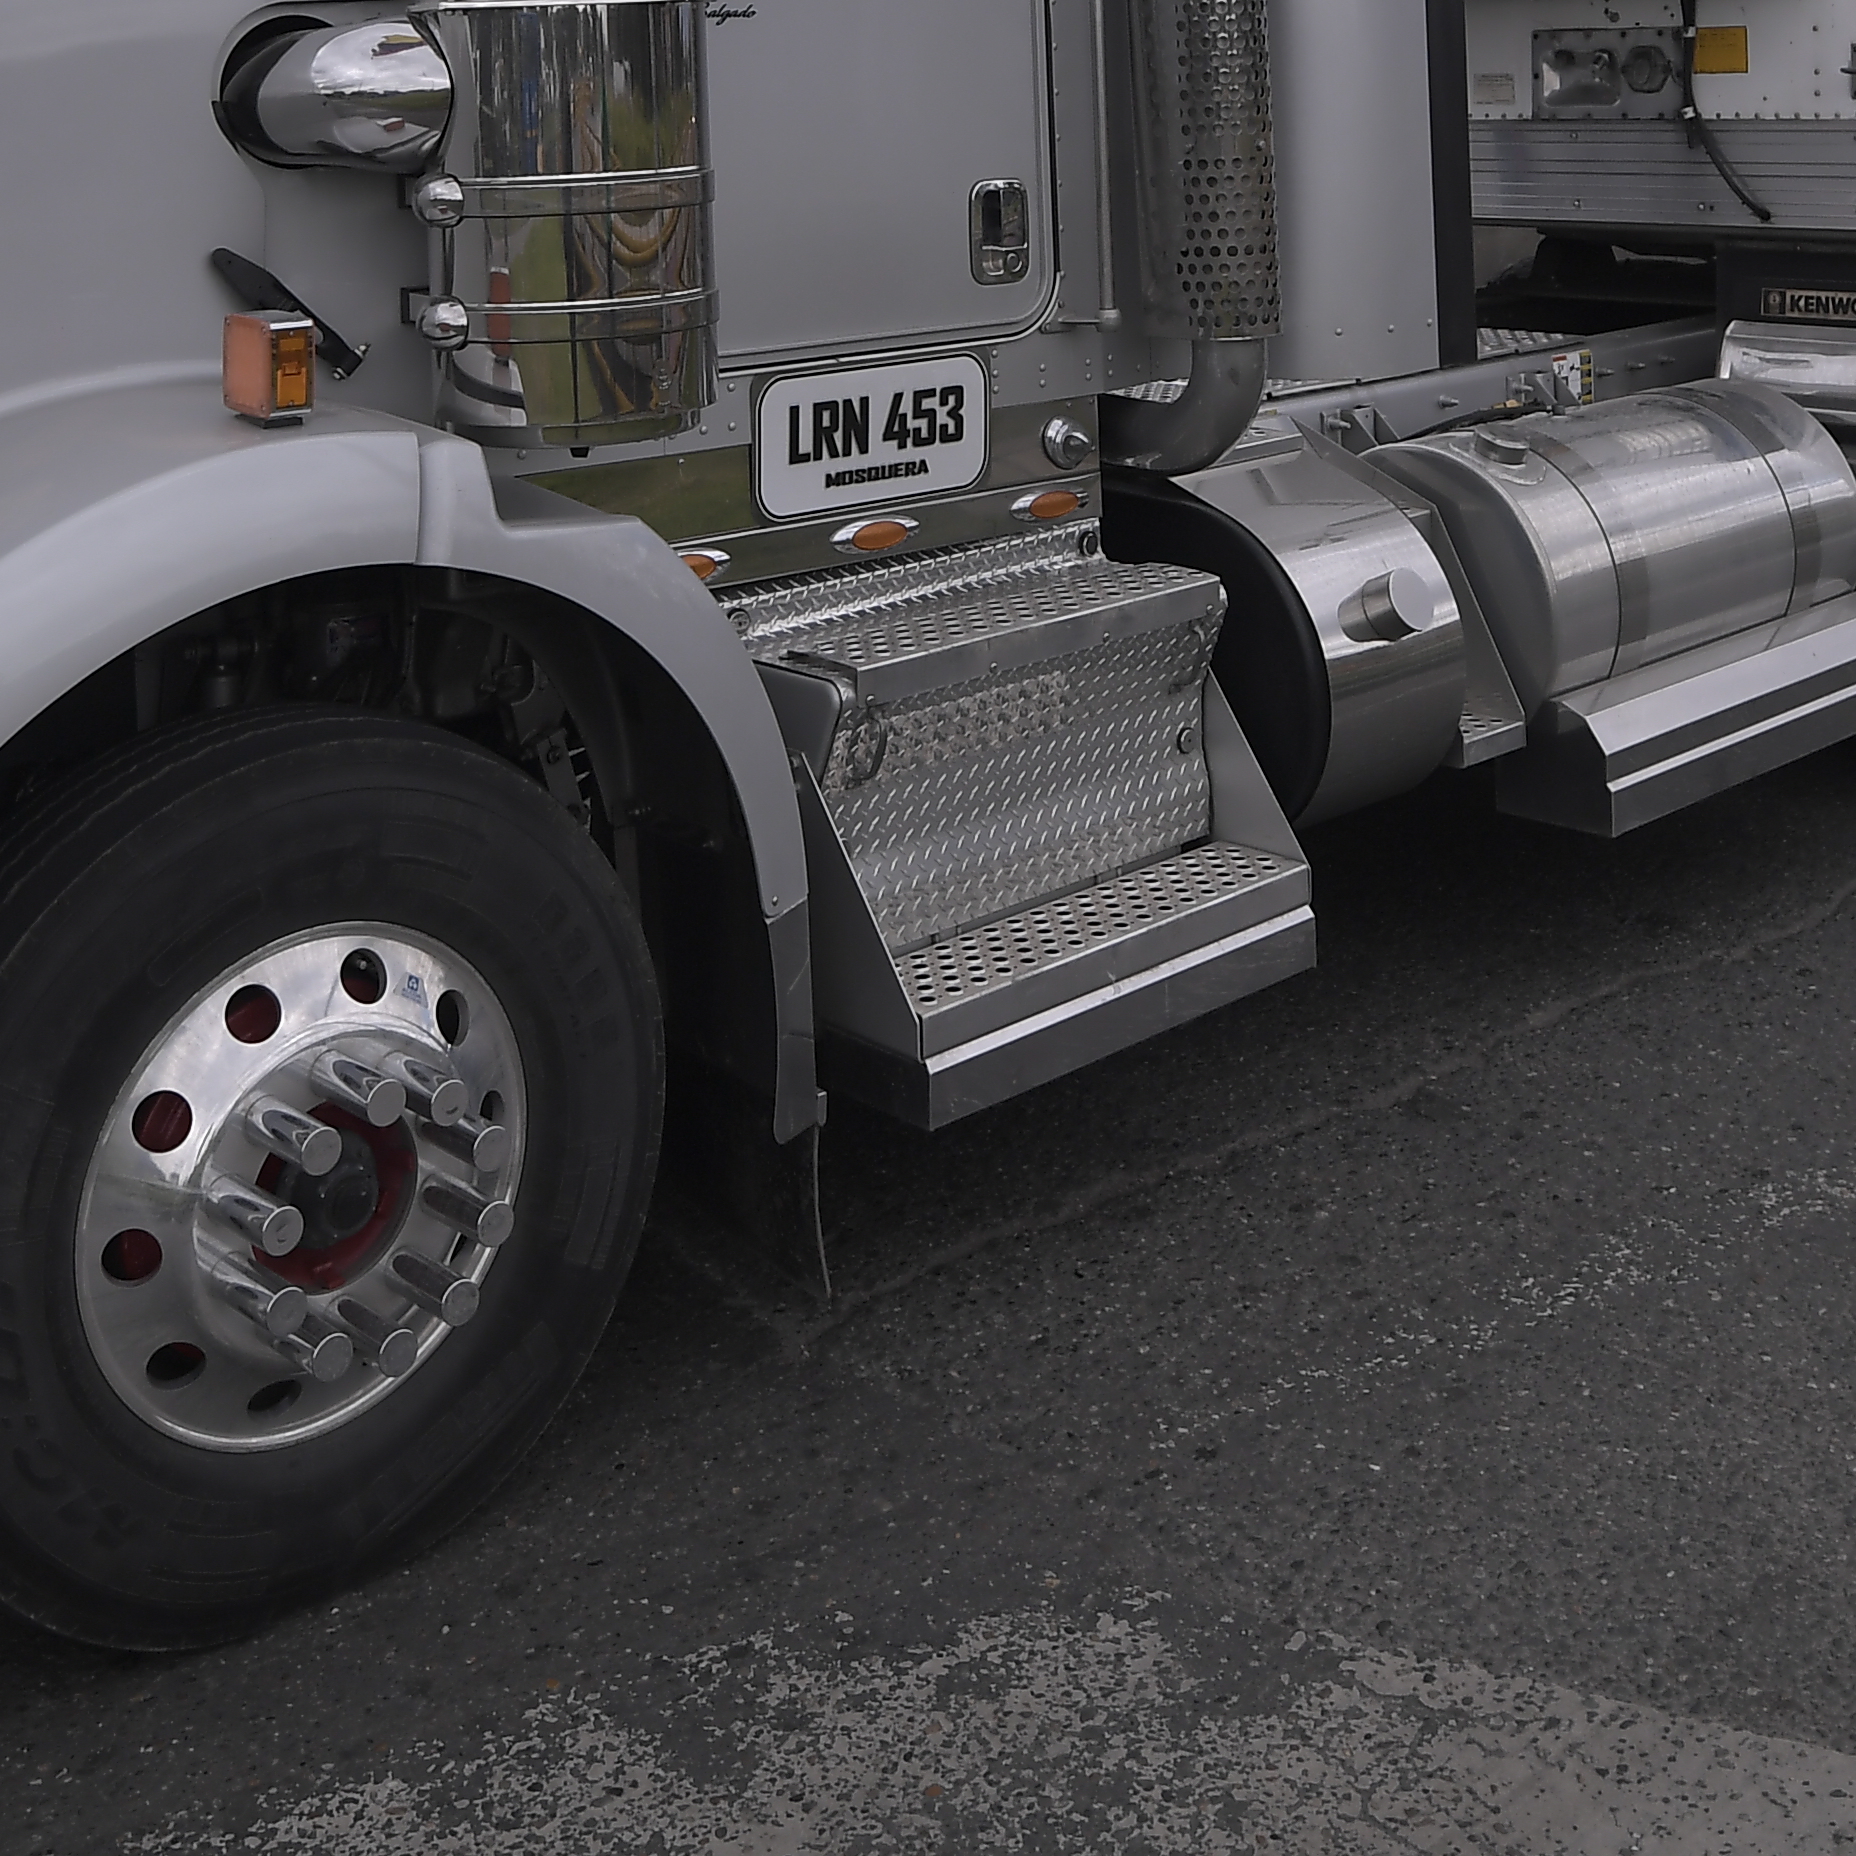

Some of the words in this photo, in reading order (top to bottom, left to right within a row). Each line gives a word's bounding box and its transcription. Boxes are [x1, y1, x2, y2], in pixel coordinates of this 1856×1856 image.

[789, 396, 870, 465] LRN
[882, 385, 965, 450] 453
[824, 459, 930, 489] MOSQUERA
